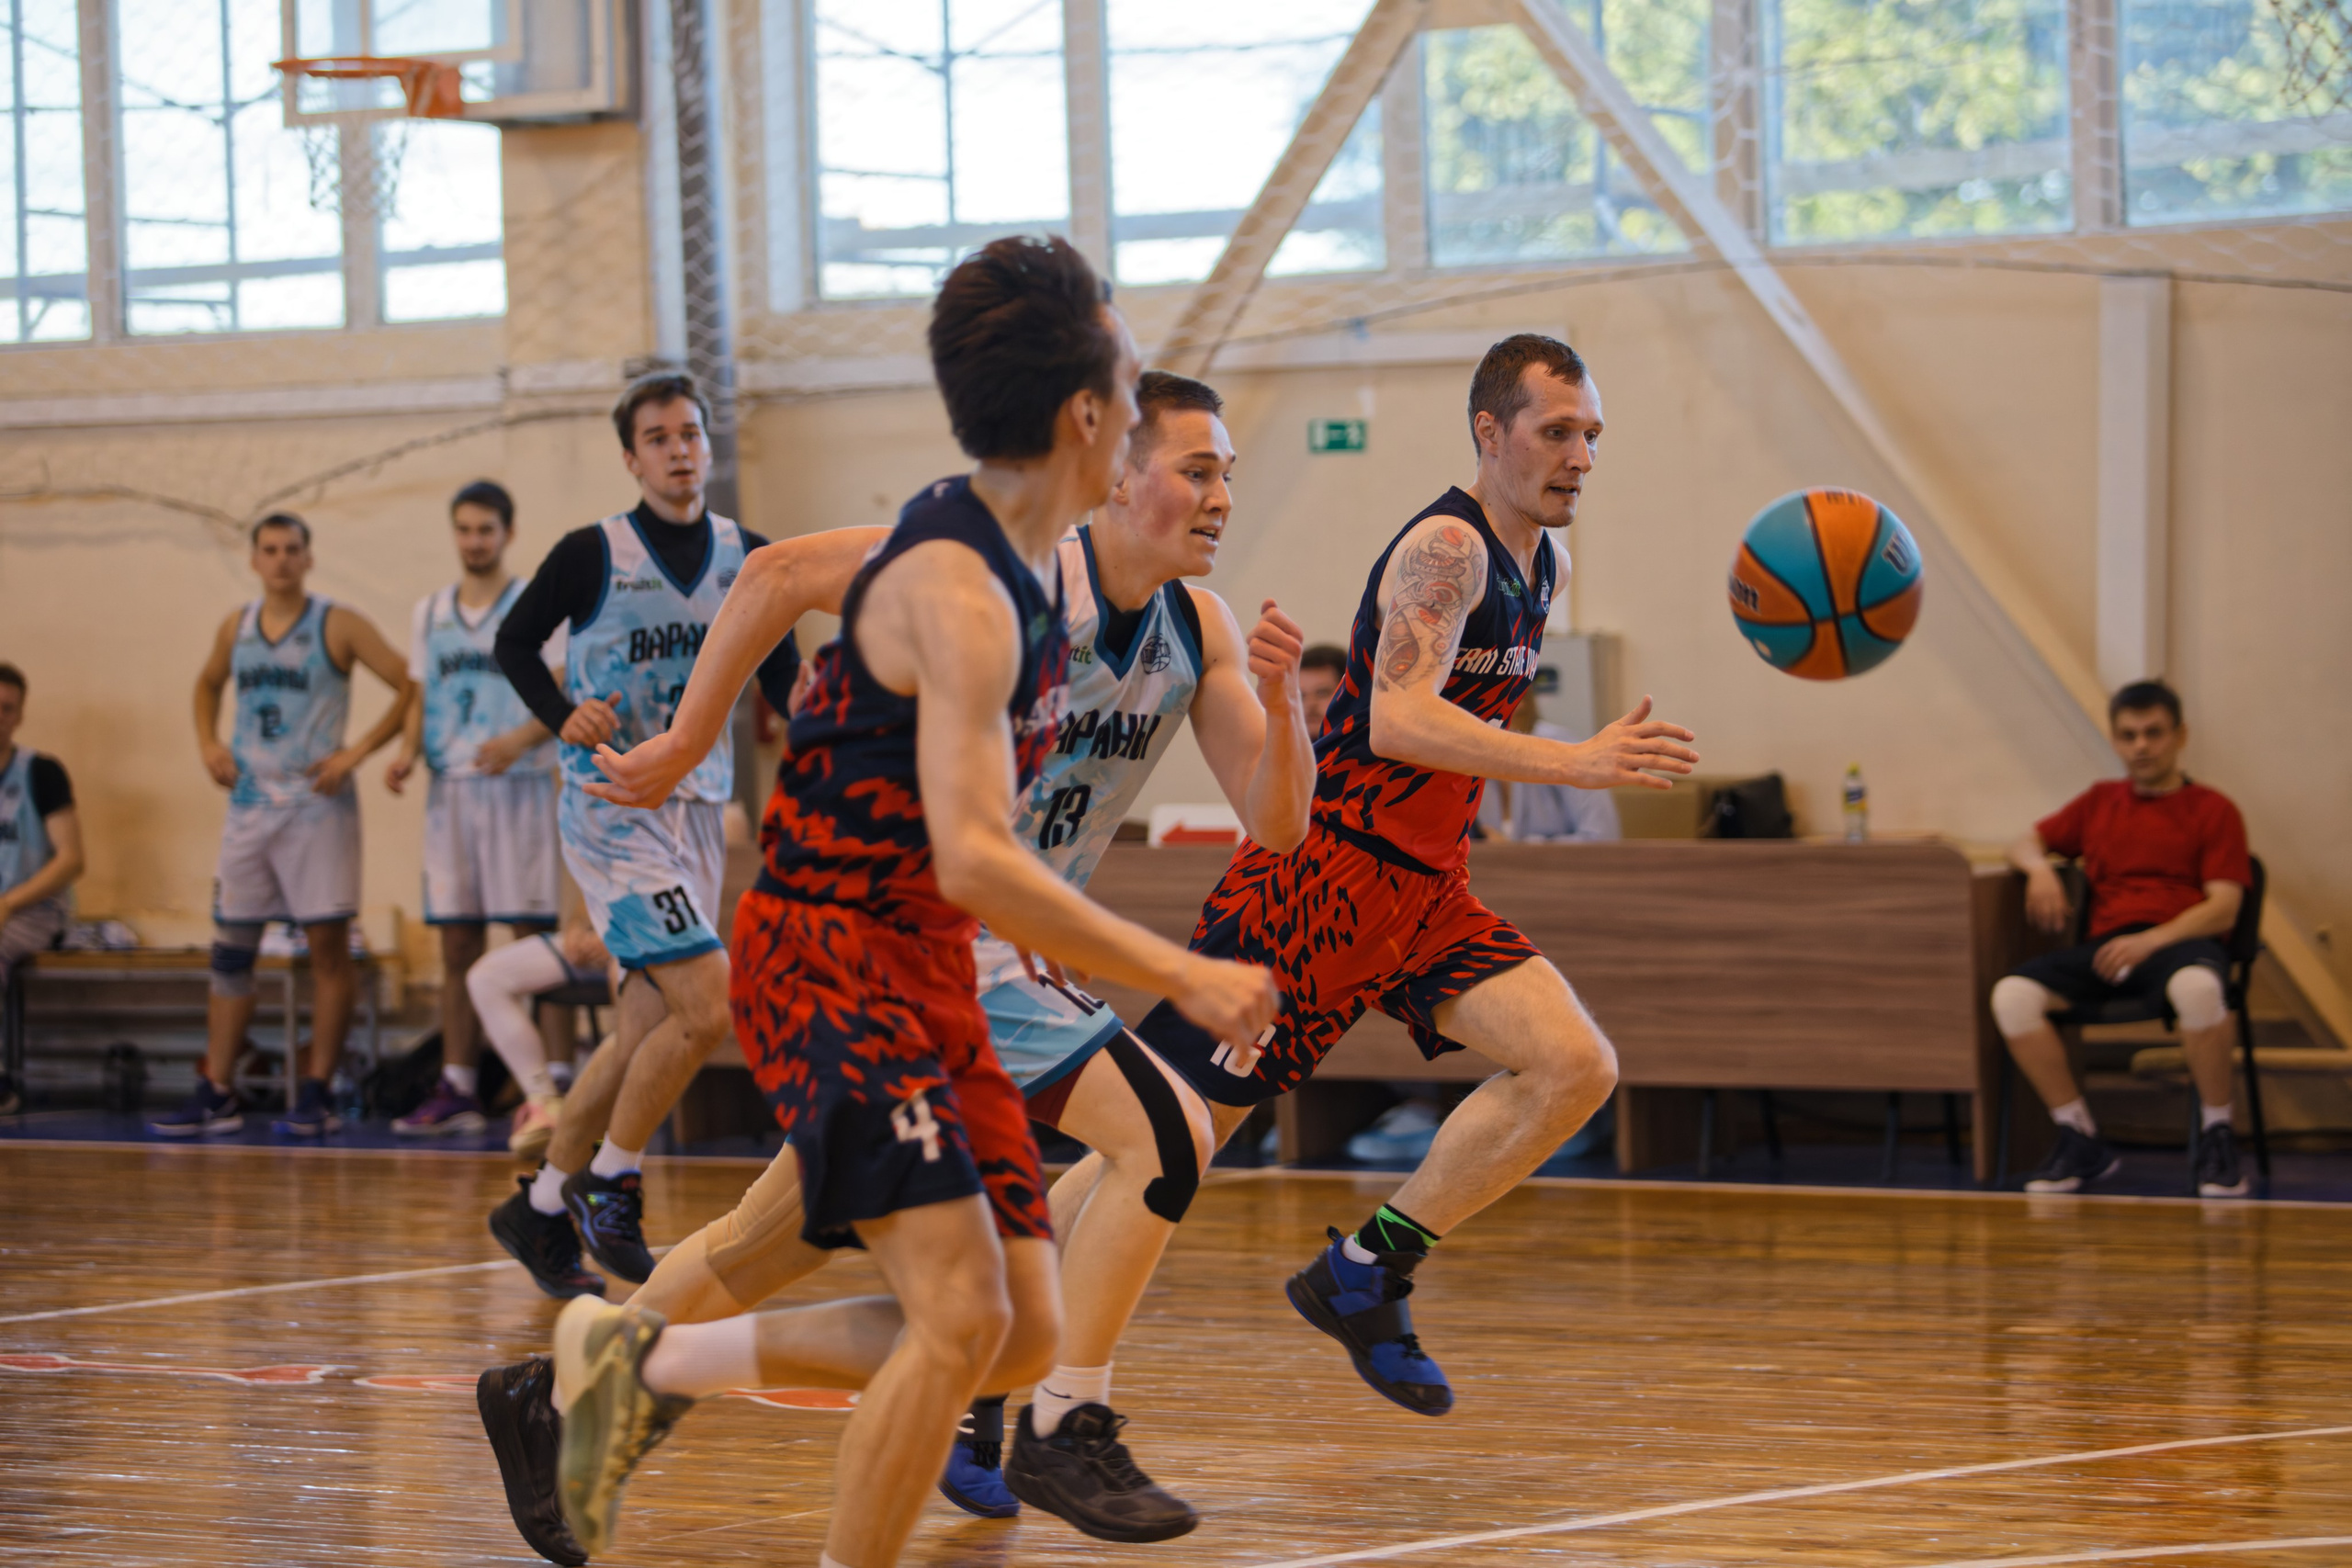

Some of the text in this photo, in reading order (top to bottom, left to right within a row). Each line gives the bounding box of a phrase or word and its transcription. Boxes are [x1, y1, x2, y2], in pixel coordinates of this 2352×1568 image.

[1038, 784, 1091, 850] 13
[653, 886, 699, 935] 31
[889, 1089, 941, 1162] 4
